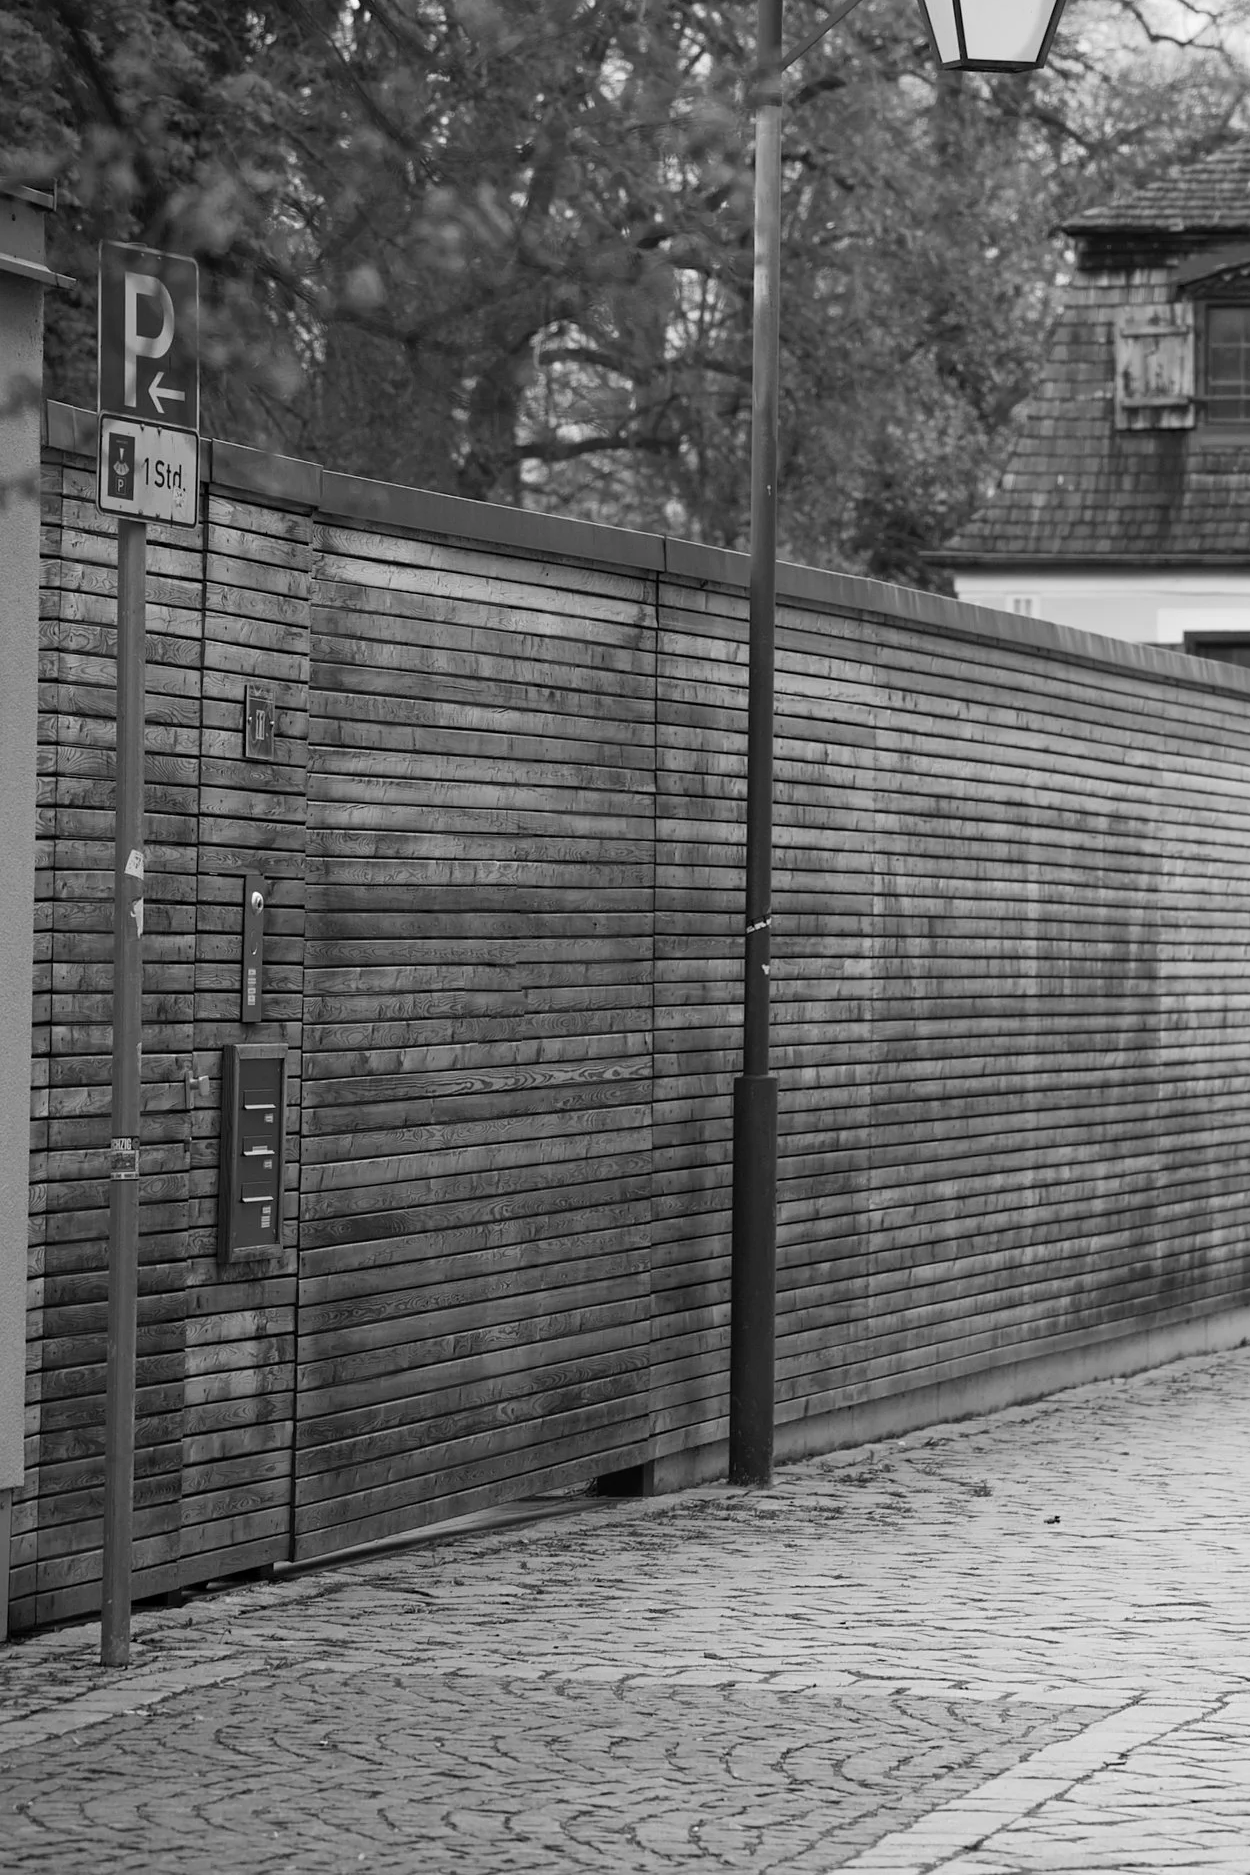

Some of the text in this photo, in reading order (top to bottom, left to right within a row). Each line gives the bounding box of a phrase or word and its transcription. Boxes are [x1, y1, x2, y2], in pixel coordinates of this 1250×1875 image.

[124, 271, 175, 408] P
[117, 478, 124, 492] P
[142, 457, 186, 492] 1 Std.
